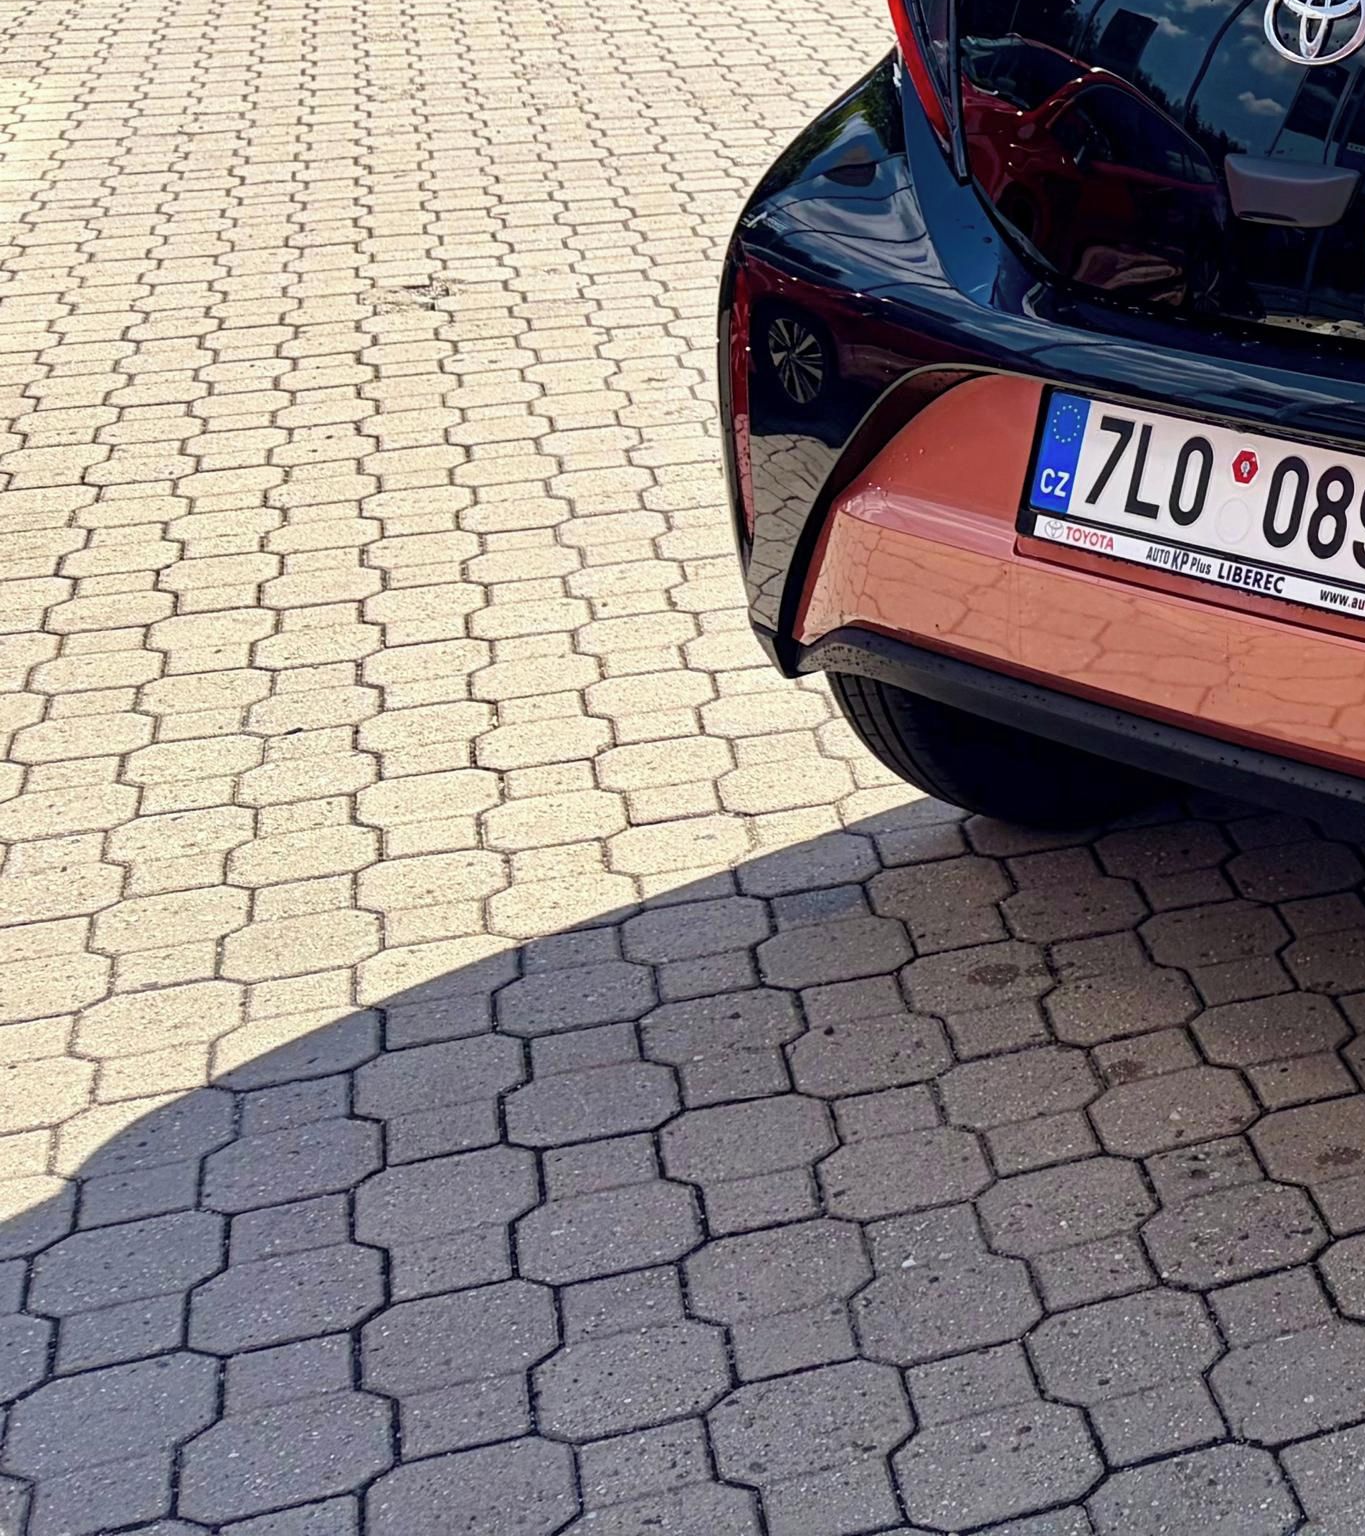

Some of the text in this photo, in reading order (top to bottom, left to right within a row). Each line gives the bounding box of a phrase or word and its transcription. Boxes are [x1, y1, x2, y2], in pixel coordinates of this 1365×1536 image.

[1040, 468, 1071, 498] CZ
[1085, 416, 1214, 527] 7L0
[1064, 525, 1114, 552] TOYOTA
[1146, 546, 1171, 564] AUTO
[1170, 549, 1190, 573] KP
[1217, 562, 1285, 595] LIBEREC
